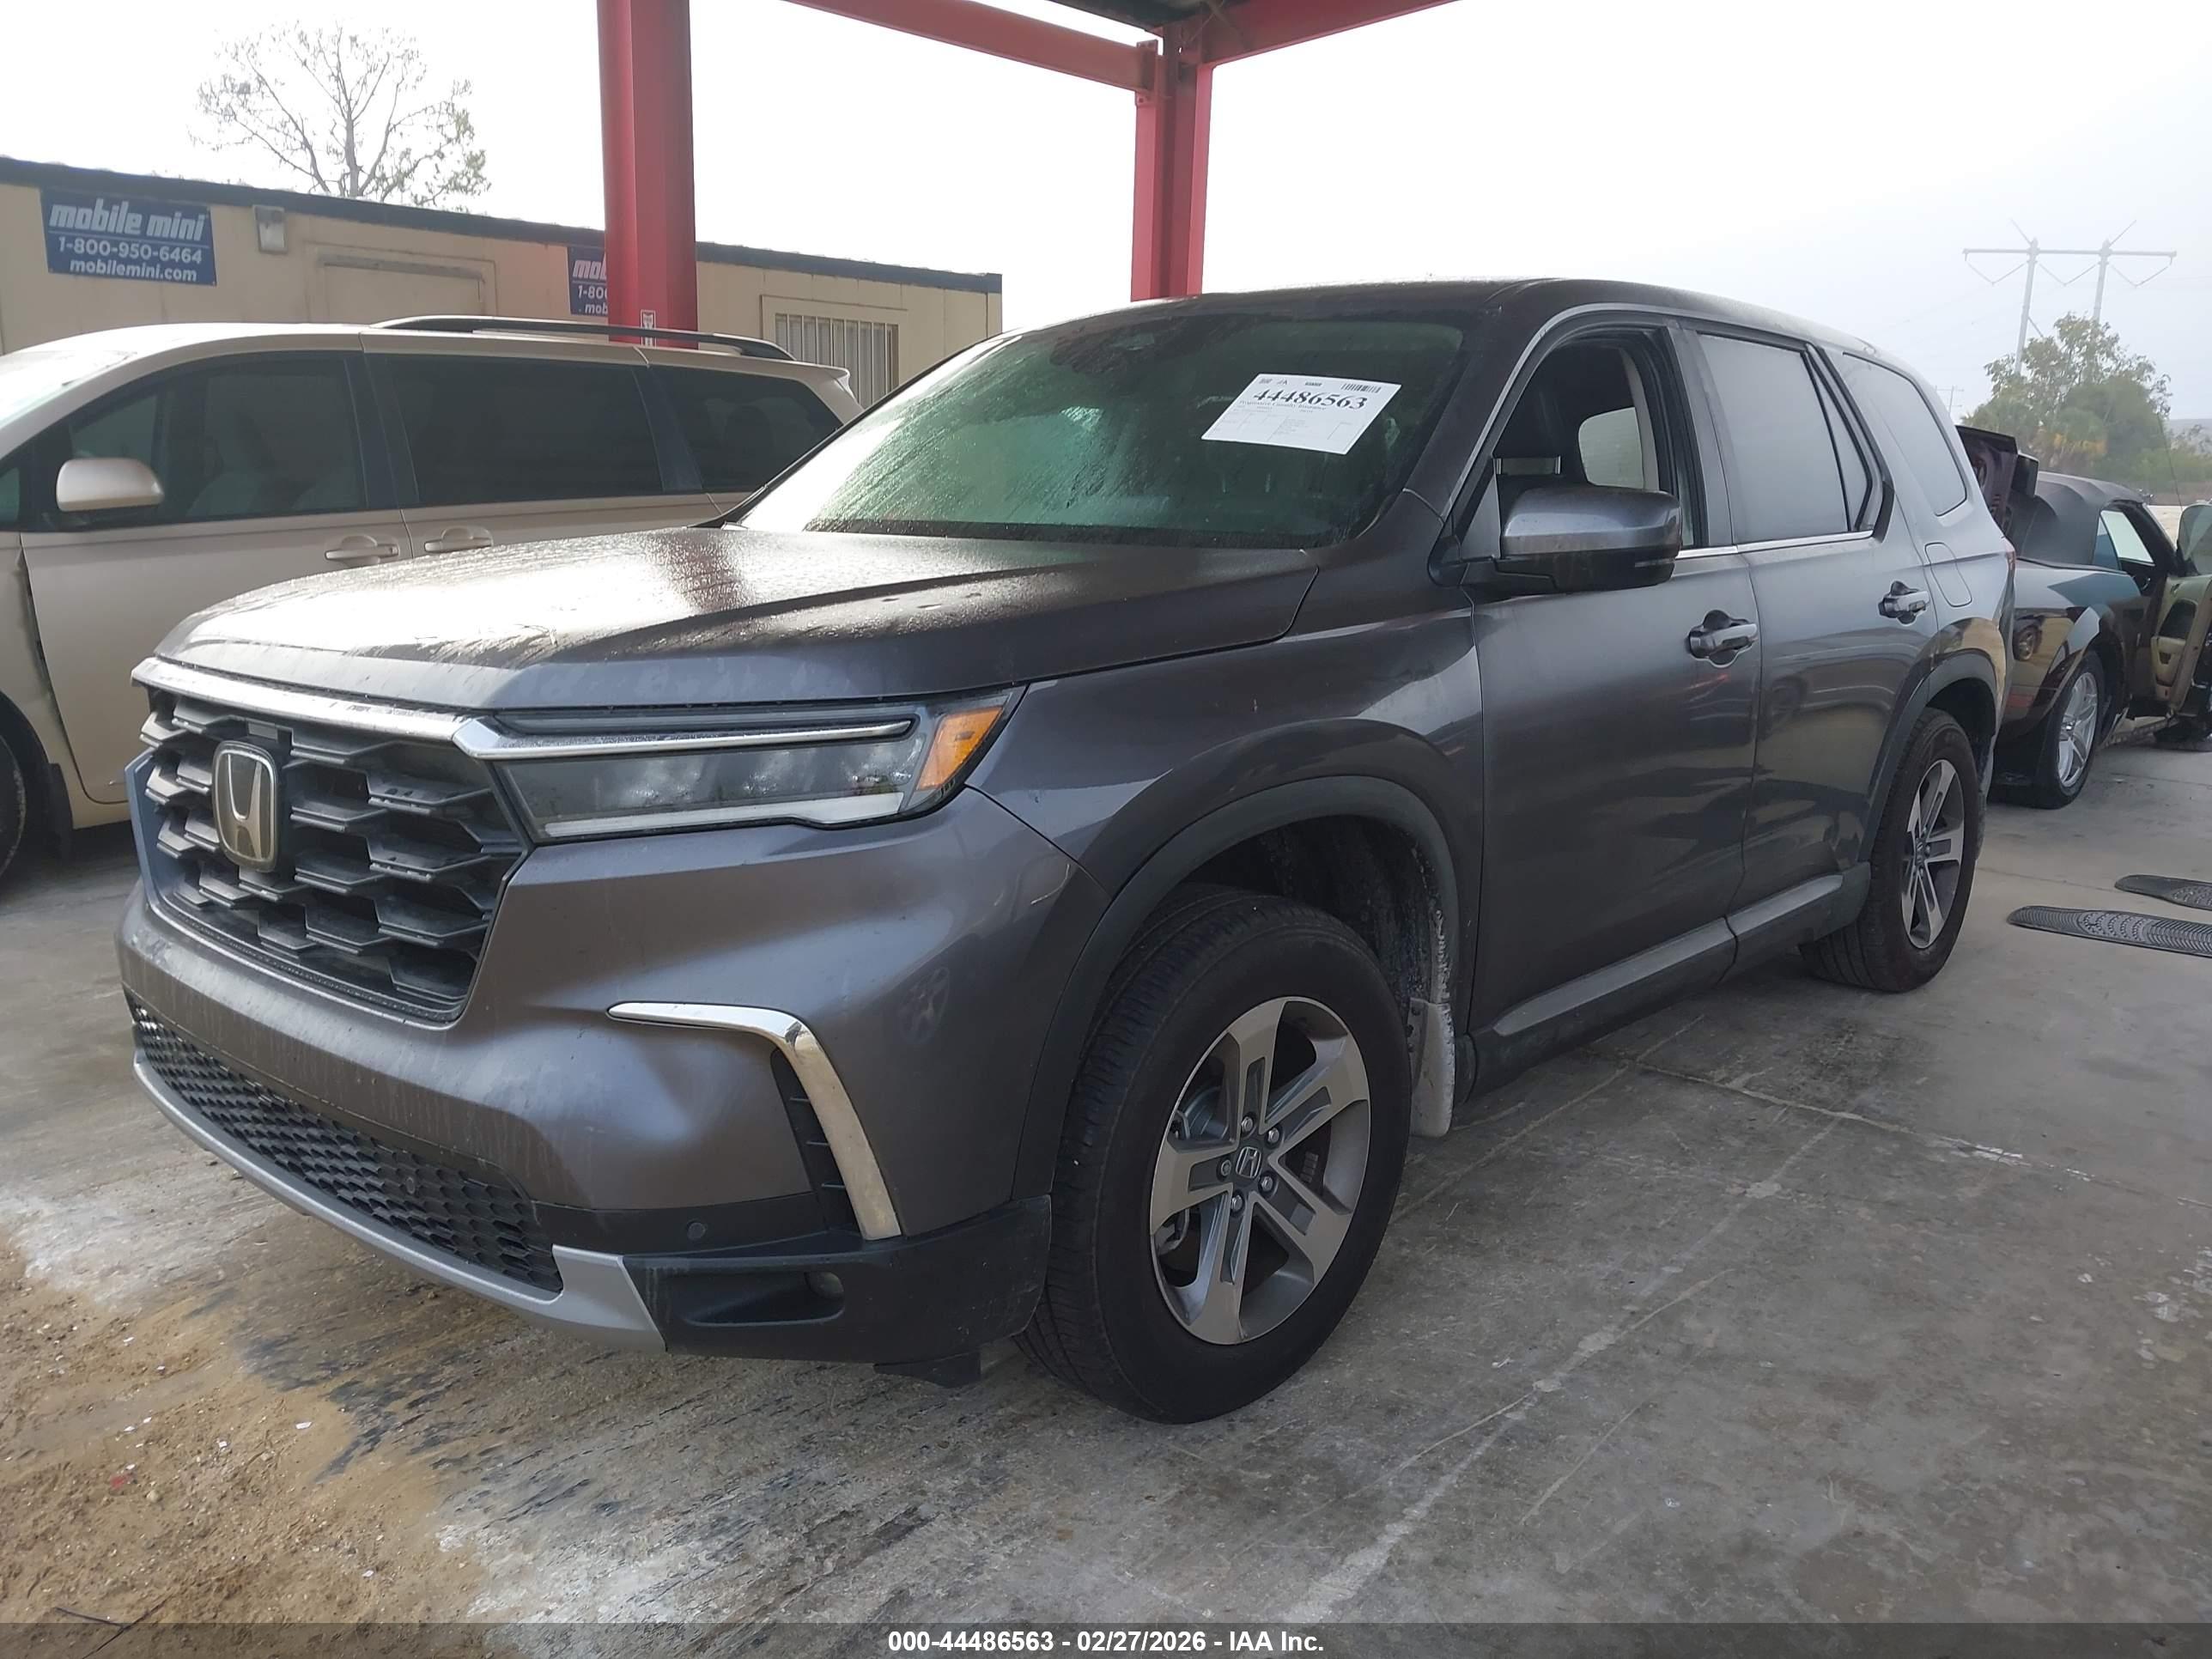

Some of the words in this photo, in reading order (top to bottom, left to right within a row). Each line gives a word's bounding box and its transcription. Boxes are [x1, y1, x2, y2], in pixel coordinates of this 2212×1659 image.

[49, 198, 142, 234] mobile
[146, 212, 205, 240] mini
[58, 236, 203, 264] 1-800-950-6464
[70, 259, 198, 283] mobilemini.com
[1254, 388, 1368, 410] 44486563
